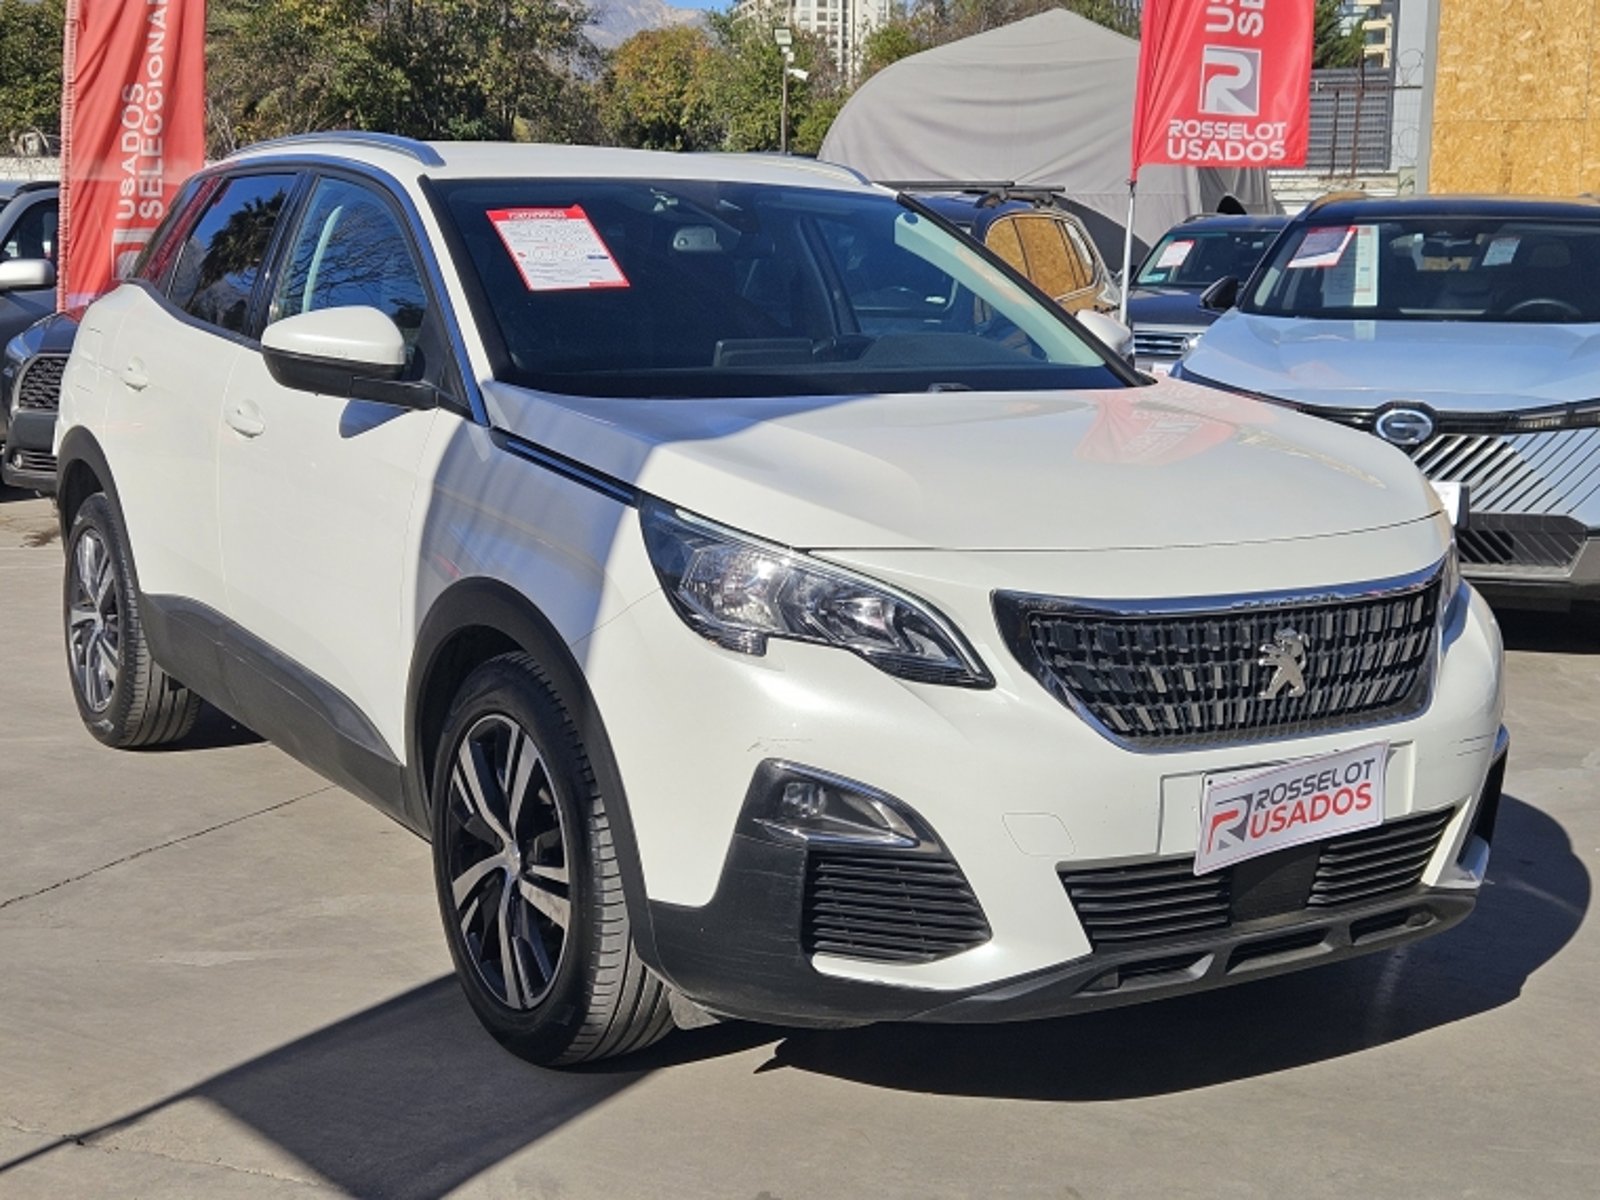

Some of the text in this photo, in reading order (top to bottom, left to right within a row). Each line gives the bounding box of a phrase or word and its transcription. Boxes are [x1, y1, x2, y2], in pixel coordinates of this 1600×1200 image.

[139, 0, 168, 219] SELECCIONA
[1168, 119, 1287, 141] ROSSELOT
[116, 83, 145, 219] USADOS
[1167, 139, 1287, 162] USADOS
[1250, 783, 1372, 839] USADOS
[1254, 758, 1375, 811] ROSSELOT
